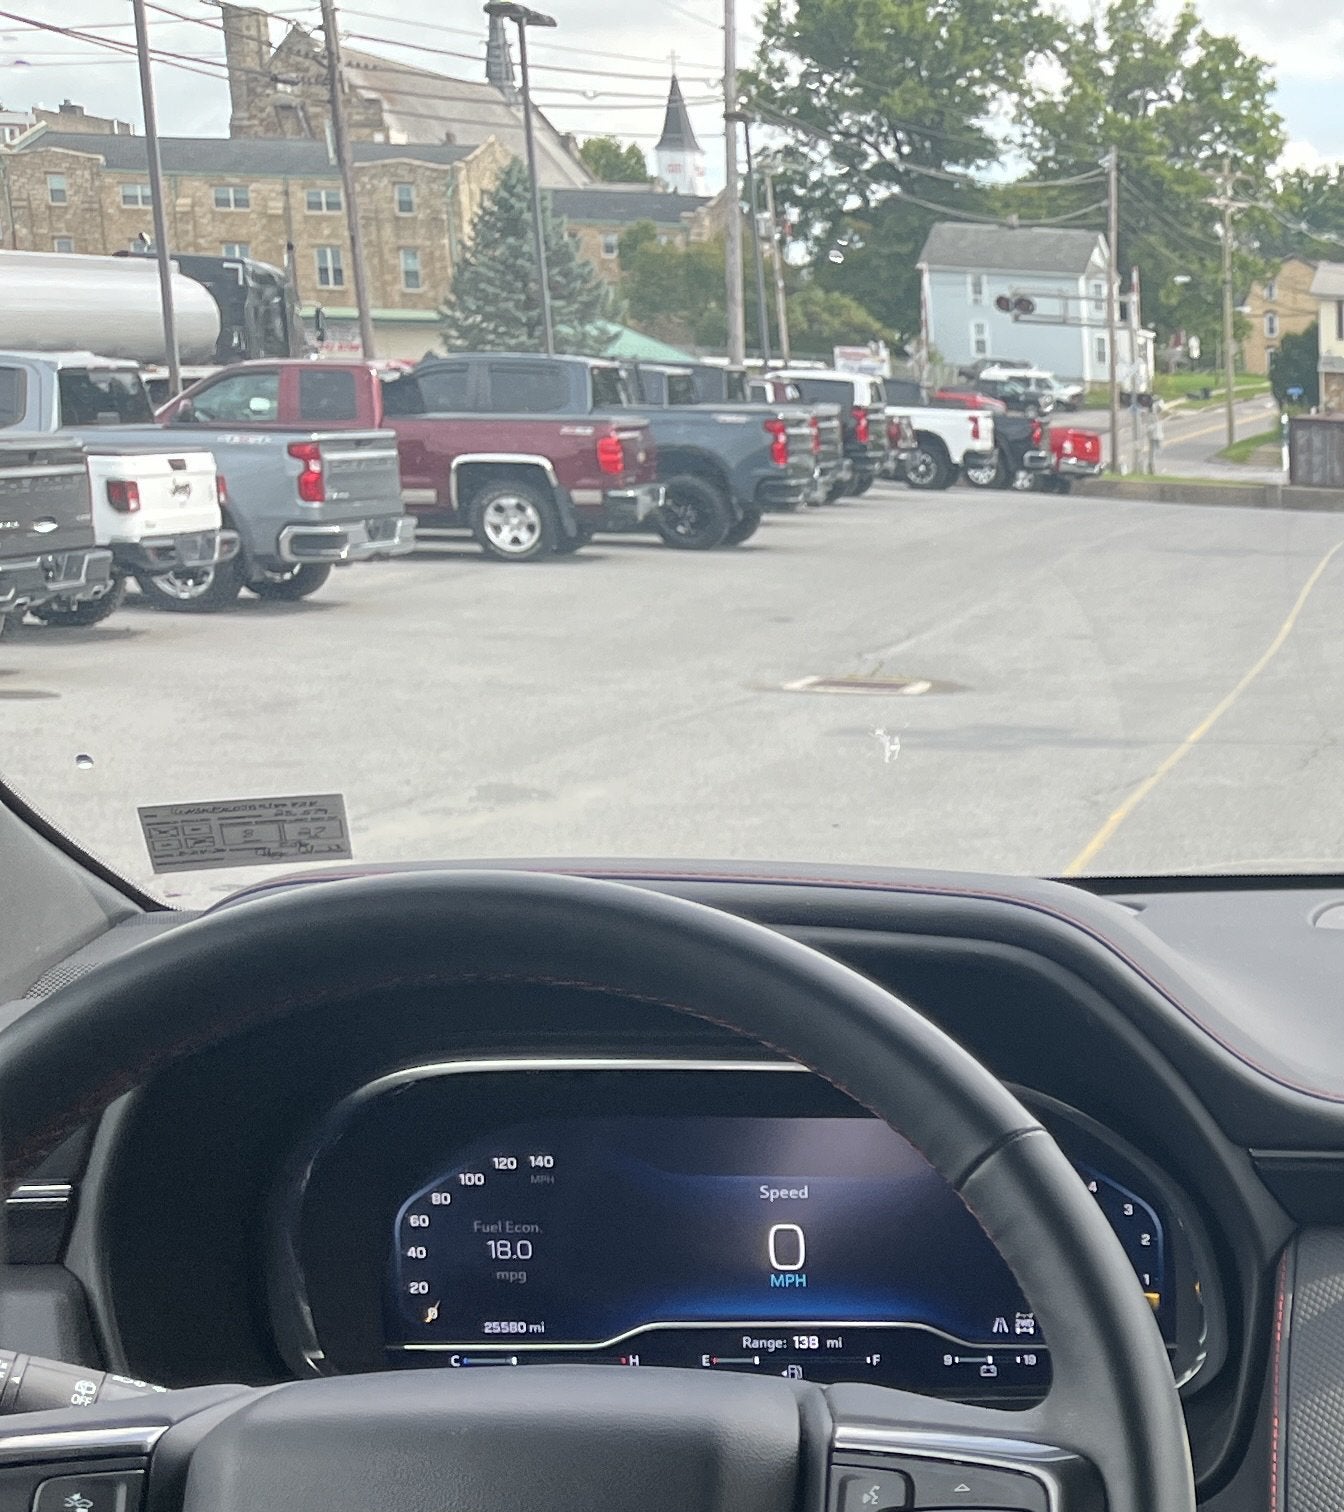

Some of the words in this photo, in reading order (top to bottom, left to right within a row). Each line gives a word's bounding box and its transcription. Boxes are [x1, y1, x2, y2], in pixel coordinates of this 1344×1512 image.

[493, 1157, 517, 1170] 120
[529, 1155, 554, 1169] 140
[459, 1173, 485, 1186] 100
[1088, 1181, 1098, 1192] 4
[431, 1192, 451, 1206] 80
[759, 1185, 809, 1202] Speed
[1123, 1203, 1134, 1216] 3
[409, 1214, 430, 1228] 60
[473, 1220, 502, 1234] Fuel
[505, 1220, 543, 1234] Econ.
[1140, 1233, 1151, 1246] 2
[406, 1246, 427, 1259] 40
[486, 1240, 533, 1260] 18.0
[768, 1223, 806, 1271] 0
[496, 1270, 527, 1284] mpg
[770, 1274, 807, 1288] MPH
[1143, 1273, 1150, 1286] 1
[409, 1281, 429, 1295] 20
[484, 1321, 527, 1334] 25580
[529, 1320, 545, 1333] mi
[742, 1336, 787, 1350] Range:
[792, 1336, 819, 1349] 138
[826, 1336, 843, 1348] mi
[450, 1355, 460, 1367] C
[629, 1355, 640, 1367] H
[701, 1354, 711, 1367] E
[872, 1354, 881, 1366] F
